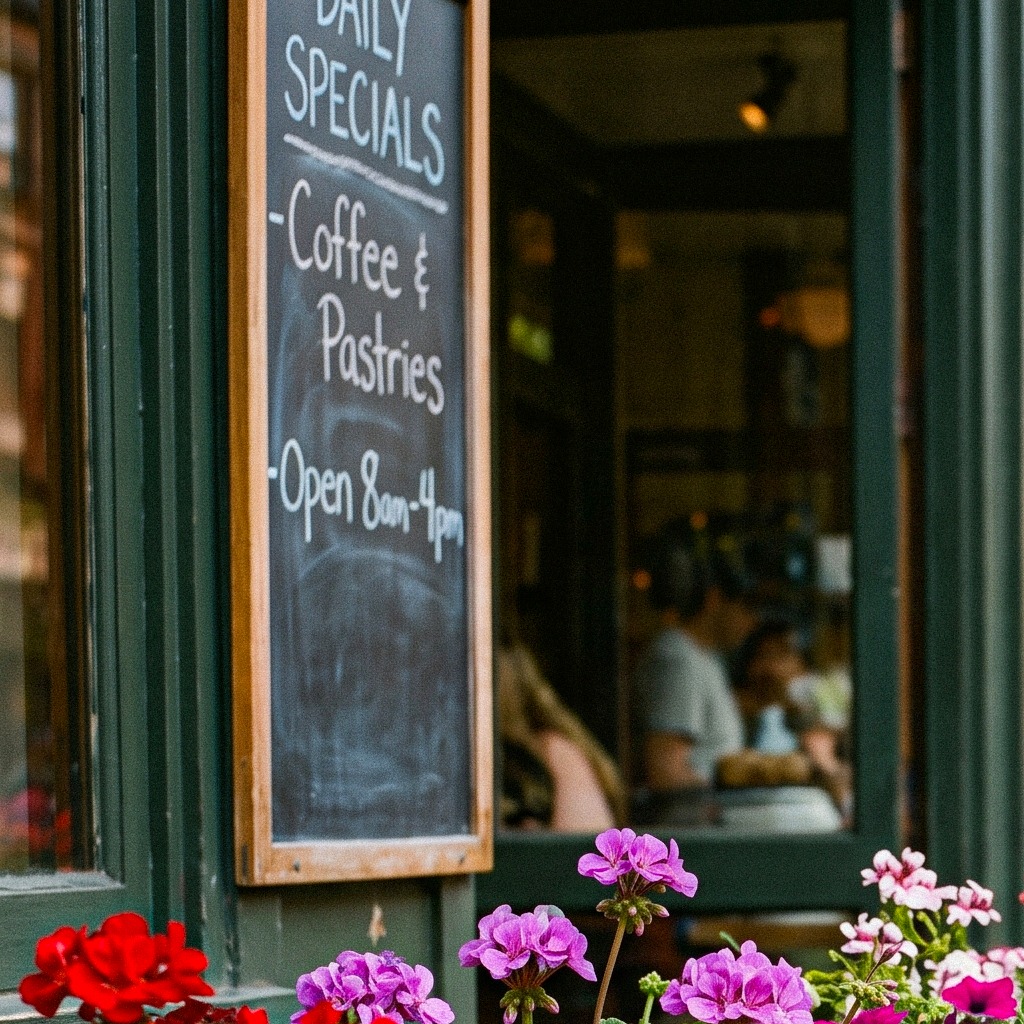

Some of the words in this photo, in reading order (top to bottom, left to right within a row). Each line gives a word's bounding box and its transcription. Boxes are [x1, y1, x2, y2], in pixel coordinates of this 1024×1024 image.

[317, 0, 410, 77] AILY
[284, 34, 445, 186] SPECIALS
[413, 233, 430, 310] &
[317, 292, 445, 415] Pastries
[361, 449, 464, 563] 8am-4pm
